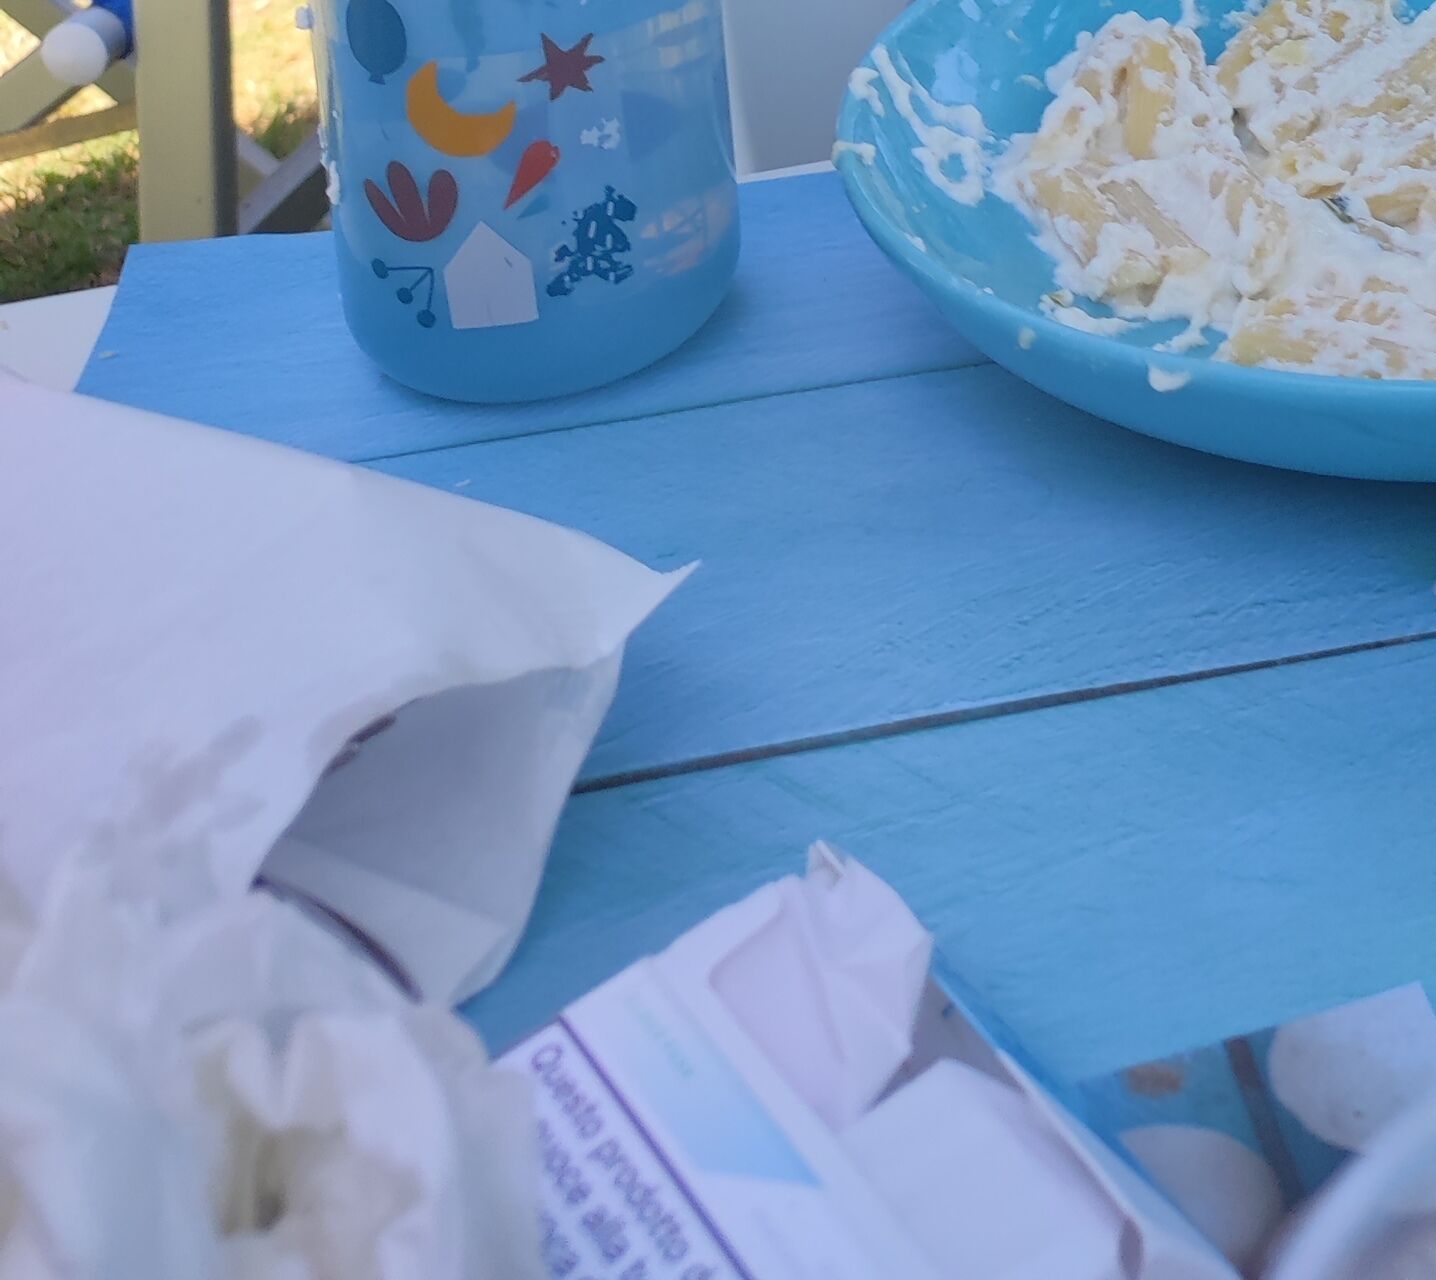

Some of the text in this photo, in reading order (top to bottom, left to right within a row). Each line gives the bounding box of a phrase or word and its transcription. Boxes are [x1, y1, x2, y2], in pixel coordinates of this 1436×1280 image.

[531, 1042, 604, 1140] Questo
[587, 1139, 691, 1264] prodotto
[580, 1207, 631, 1264] alla
